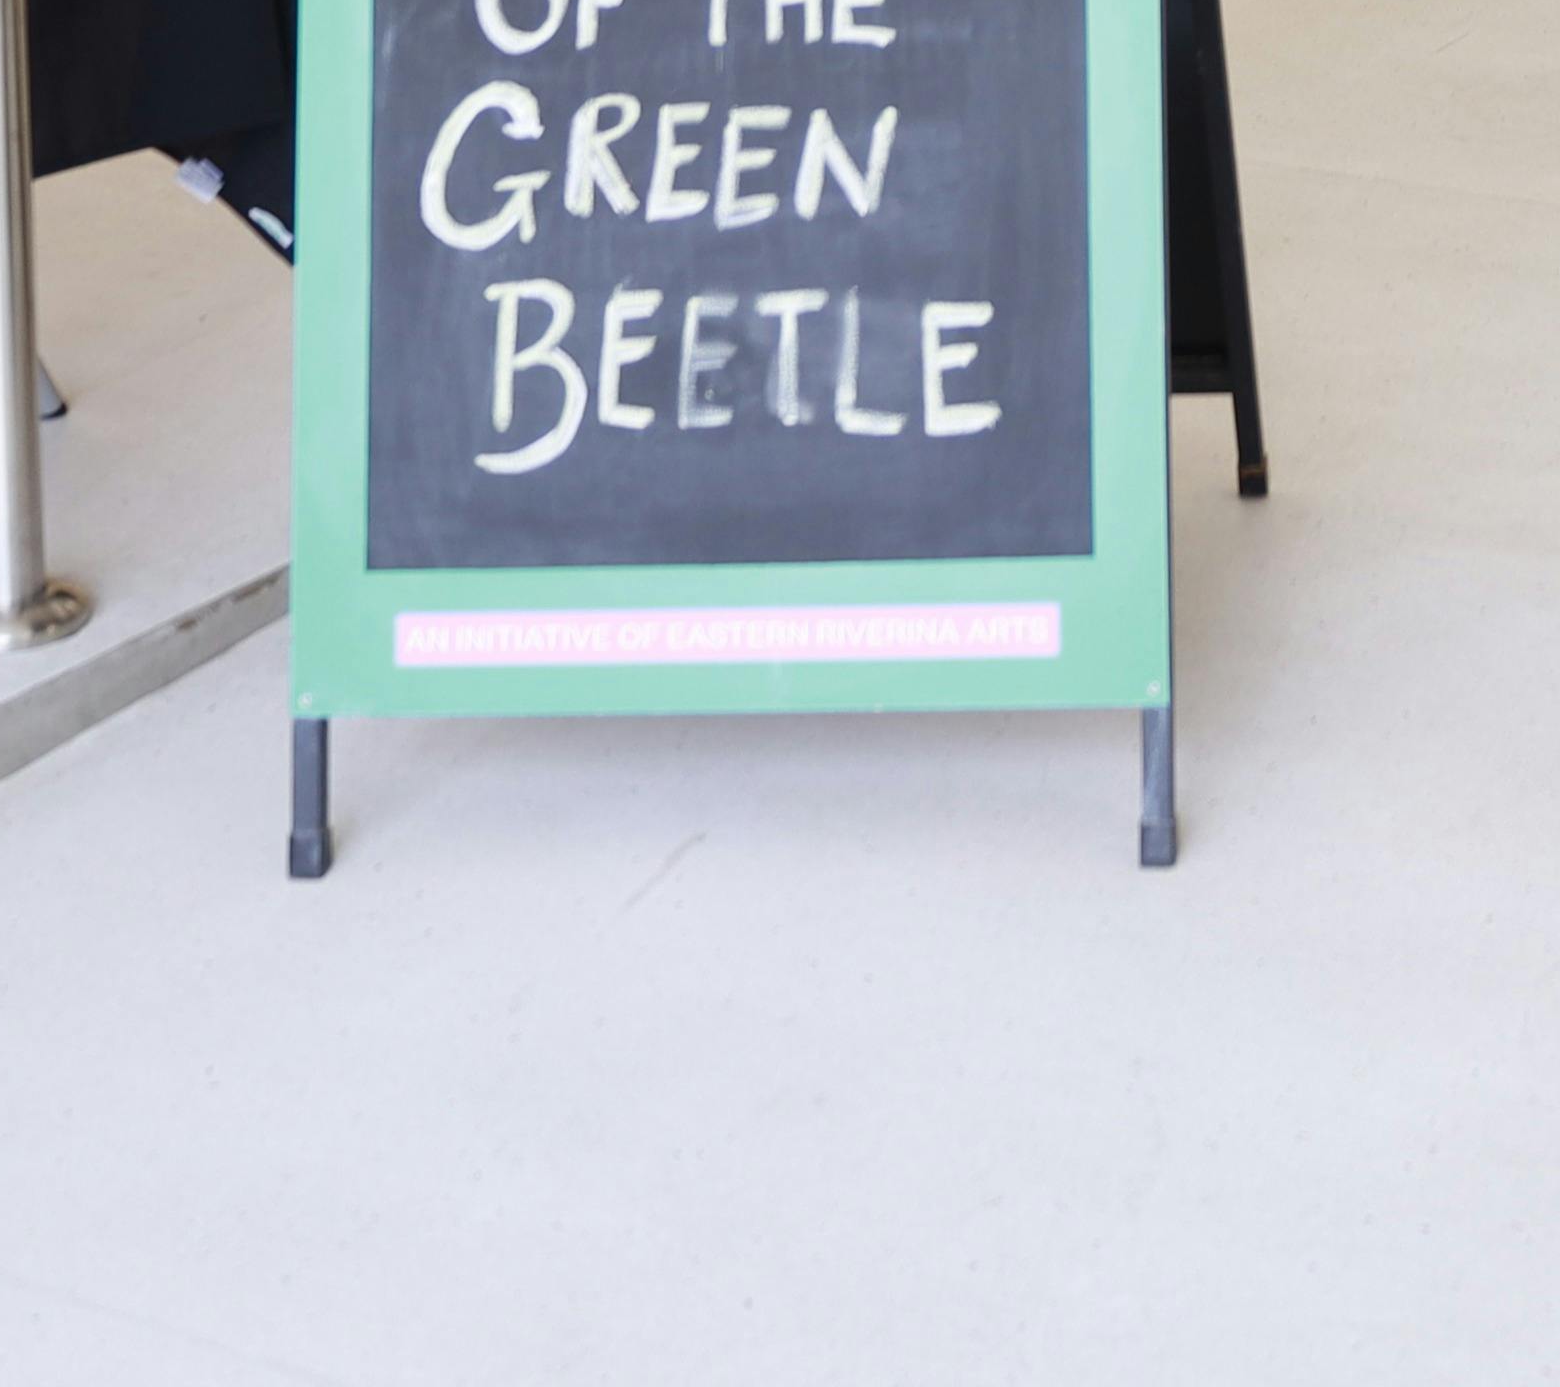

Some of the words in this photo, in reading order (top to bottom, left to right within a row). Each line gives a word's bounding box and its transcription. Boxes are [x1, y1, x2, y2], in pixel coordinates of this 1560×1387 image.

[420, 80, 898, 251] GREEN
[473, 277, 1002, 475] BEETLE
[404, 626, 449, 654] AN
[454, 621, 610, 654] INITIATIVE
[615, 620, 660, 651] OF
[665, 616, 809, 651] EASTERN
[815, 613, 960, 648] RIVERINA
[965, 612, 1050, 645] ARTS
